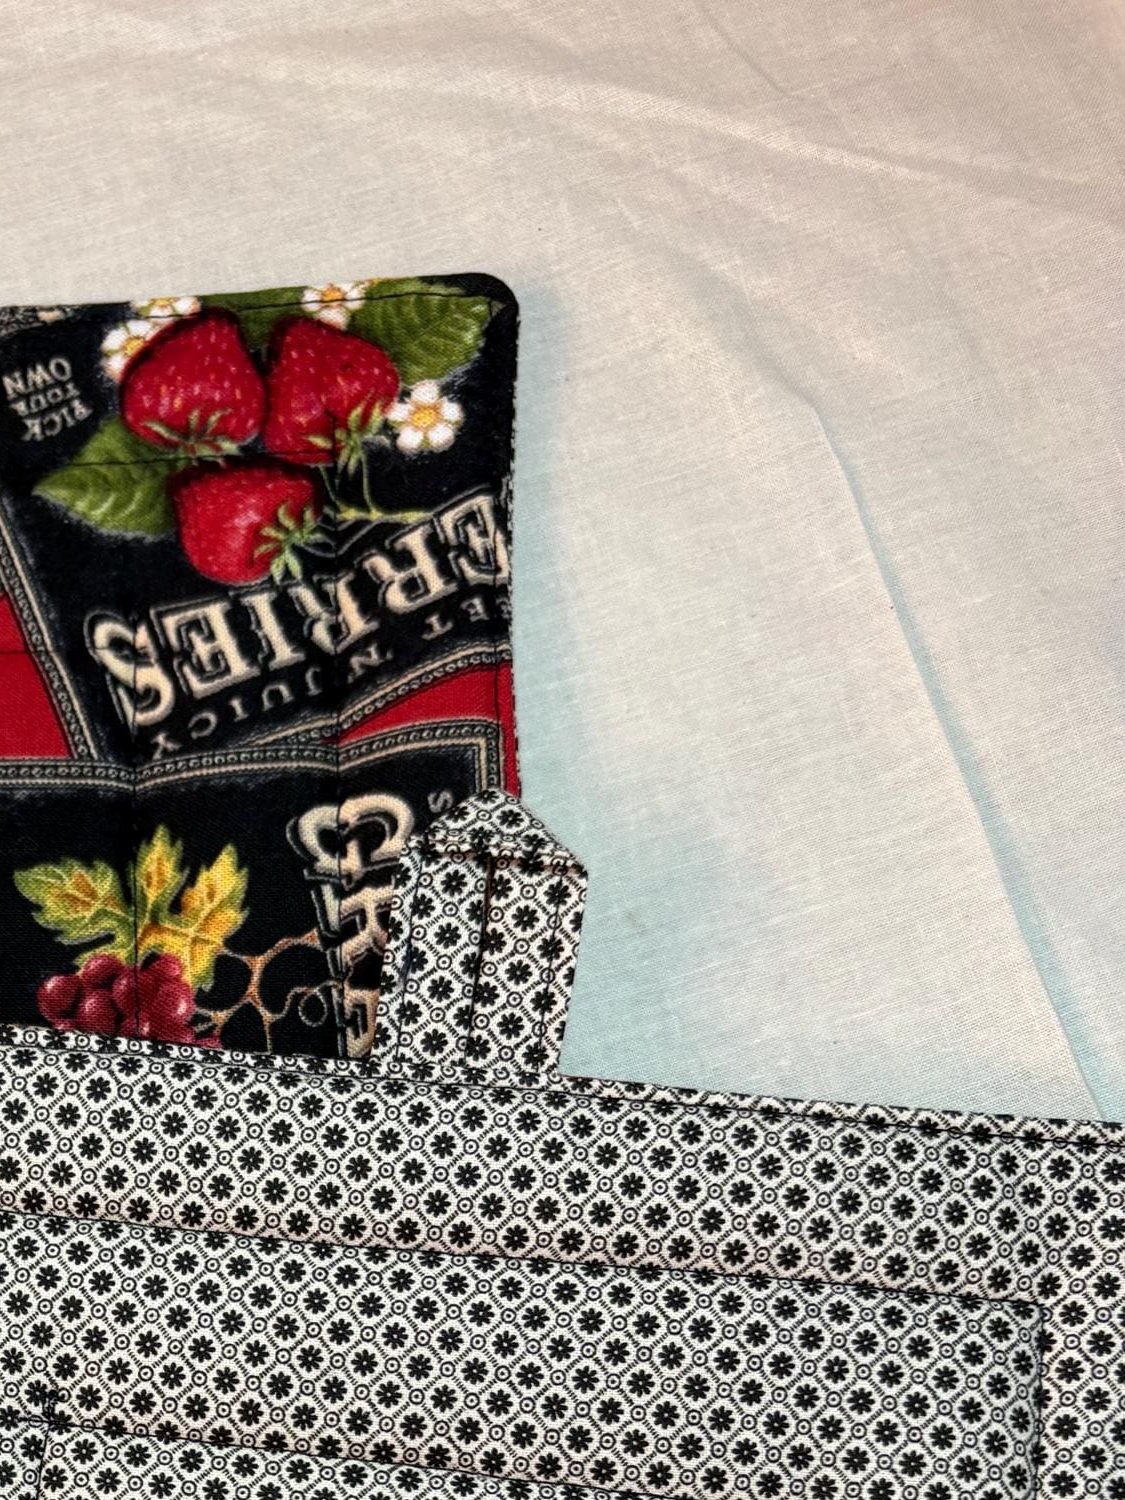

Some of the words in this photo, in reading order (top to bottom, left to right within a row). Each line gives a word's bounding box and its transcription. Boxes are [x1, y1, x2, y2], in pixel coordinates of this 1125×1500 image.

[2, 357, 72, 400] OWN
[22, 398, 93, 441] PICK
[148, 666, 328, 761] JUICY
